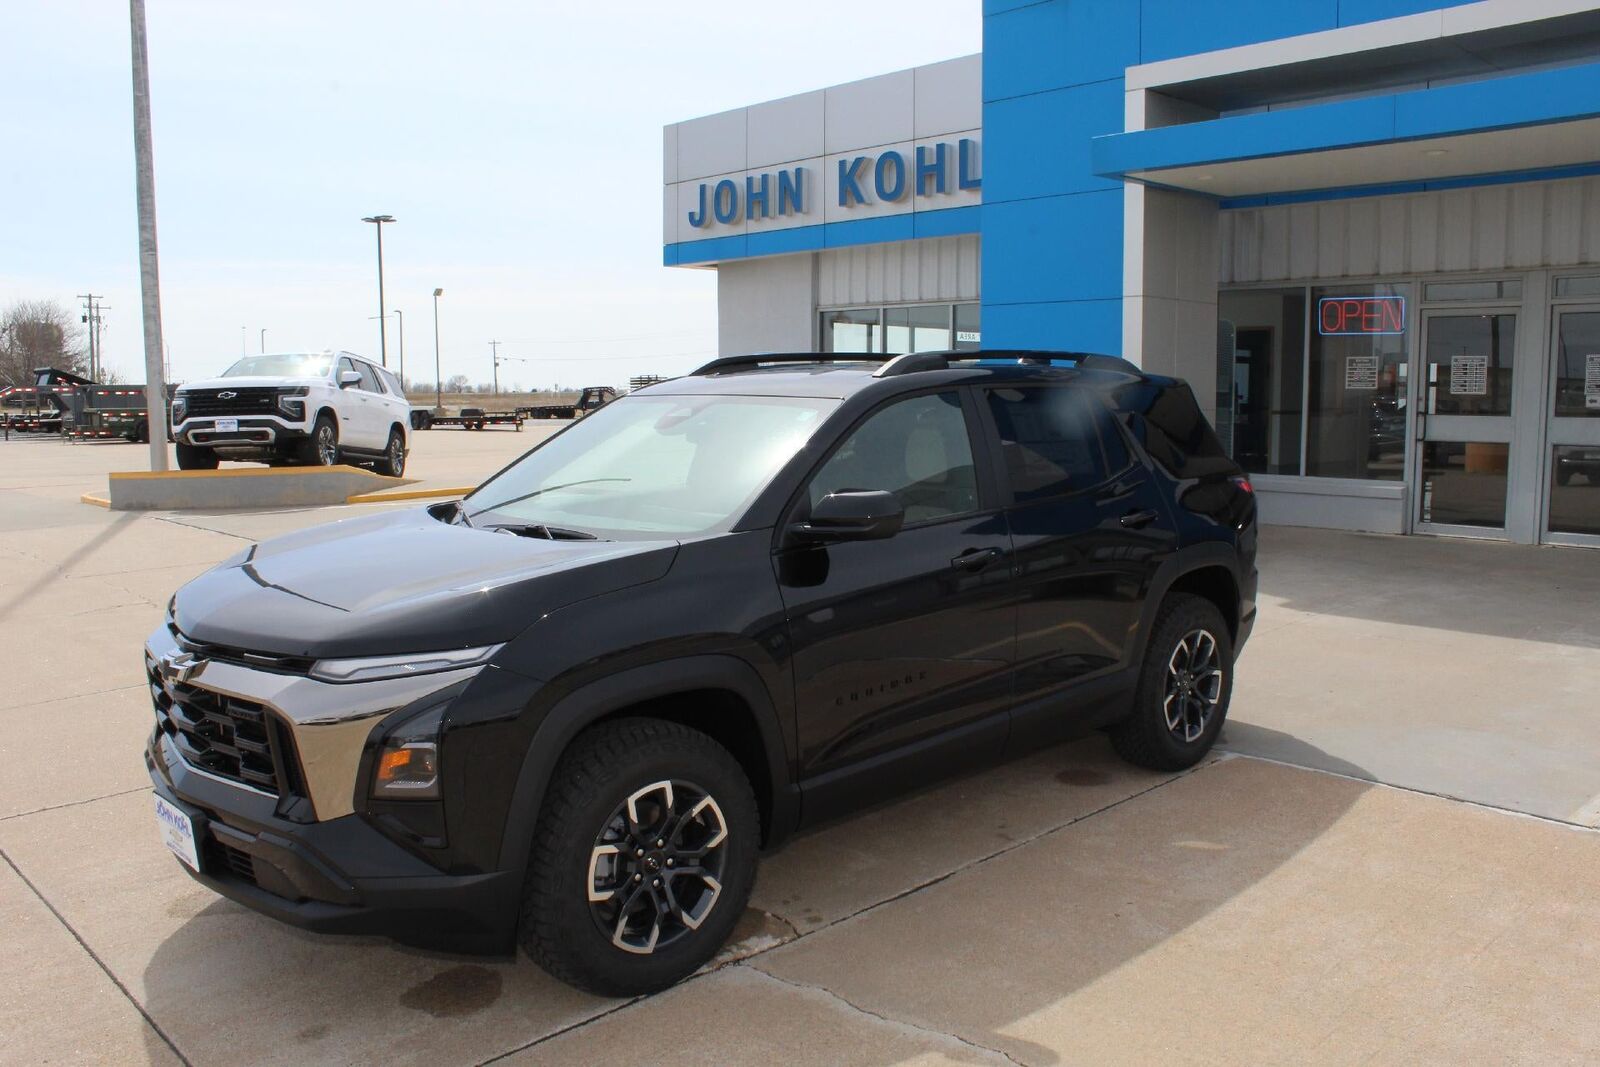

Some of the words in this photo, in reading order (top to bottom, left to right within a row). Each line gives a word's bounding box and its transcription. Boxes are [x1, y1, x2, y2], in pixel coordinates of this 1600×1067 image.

[688, 167, 806, 228] JOHN
[838, 138, 982, 208] KOHL
[1323, 300, 1401, 331] OPEN
